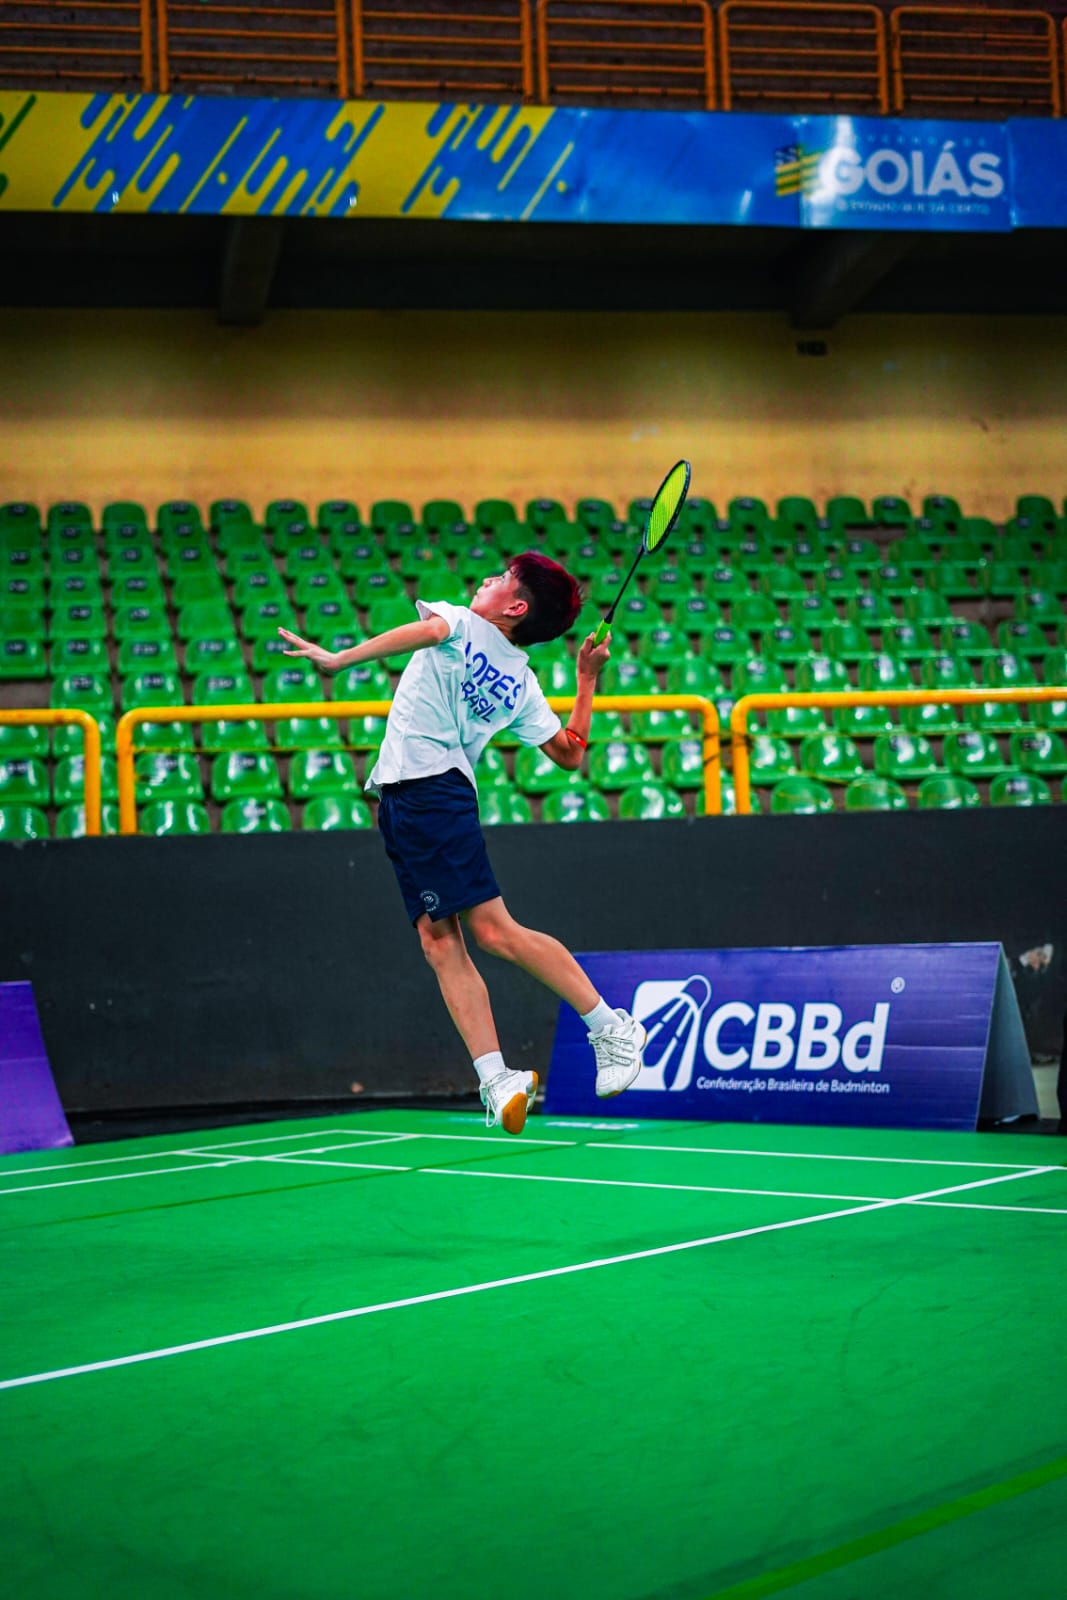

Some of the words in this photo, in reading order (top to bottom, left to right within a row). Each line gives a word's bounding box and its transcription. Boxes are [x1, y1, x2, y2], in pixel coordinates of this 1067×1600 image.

[821, 141, 1004, 198] GOIÁS
[461, 680, 496, 723] RASIL
[703, 1001, 890, 1073] CBBd
[696, 1076, 766, 1093] Confederação
[767, 1078, 814, 1092] Brasileira
[815, 1079, 829, 1092] de
[830, 1079, 890, 1093] Badminton
